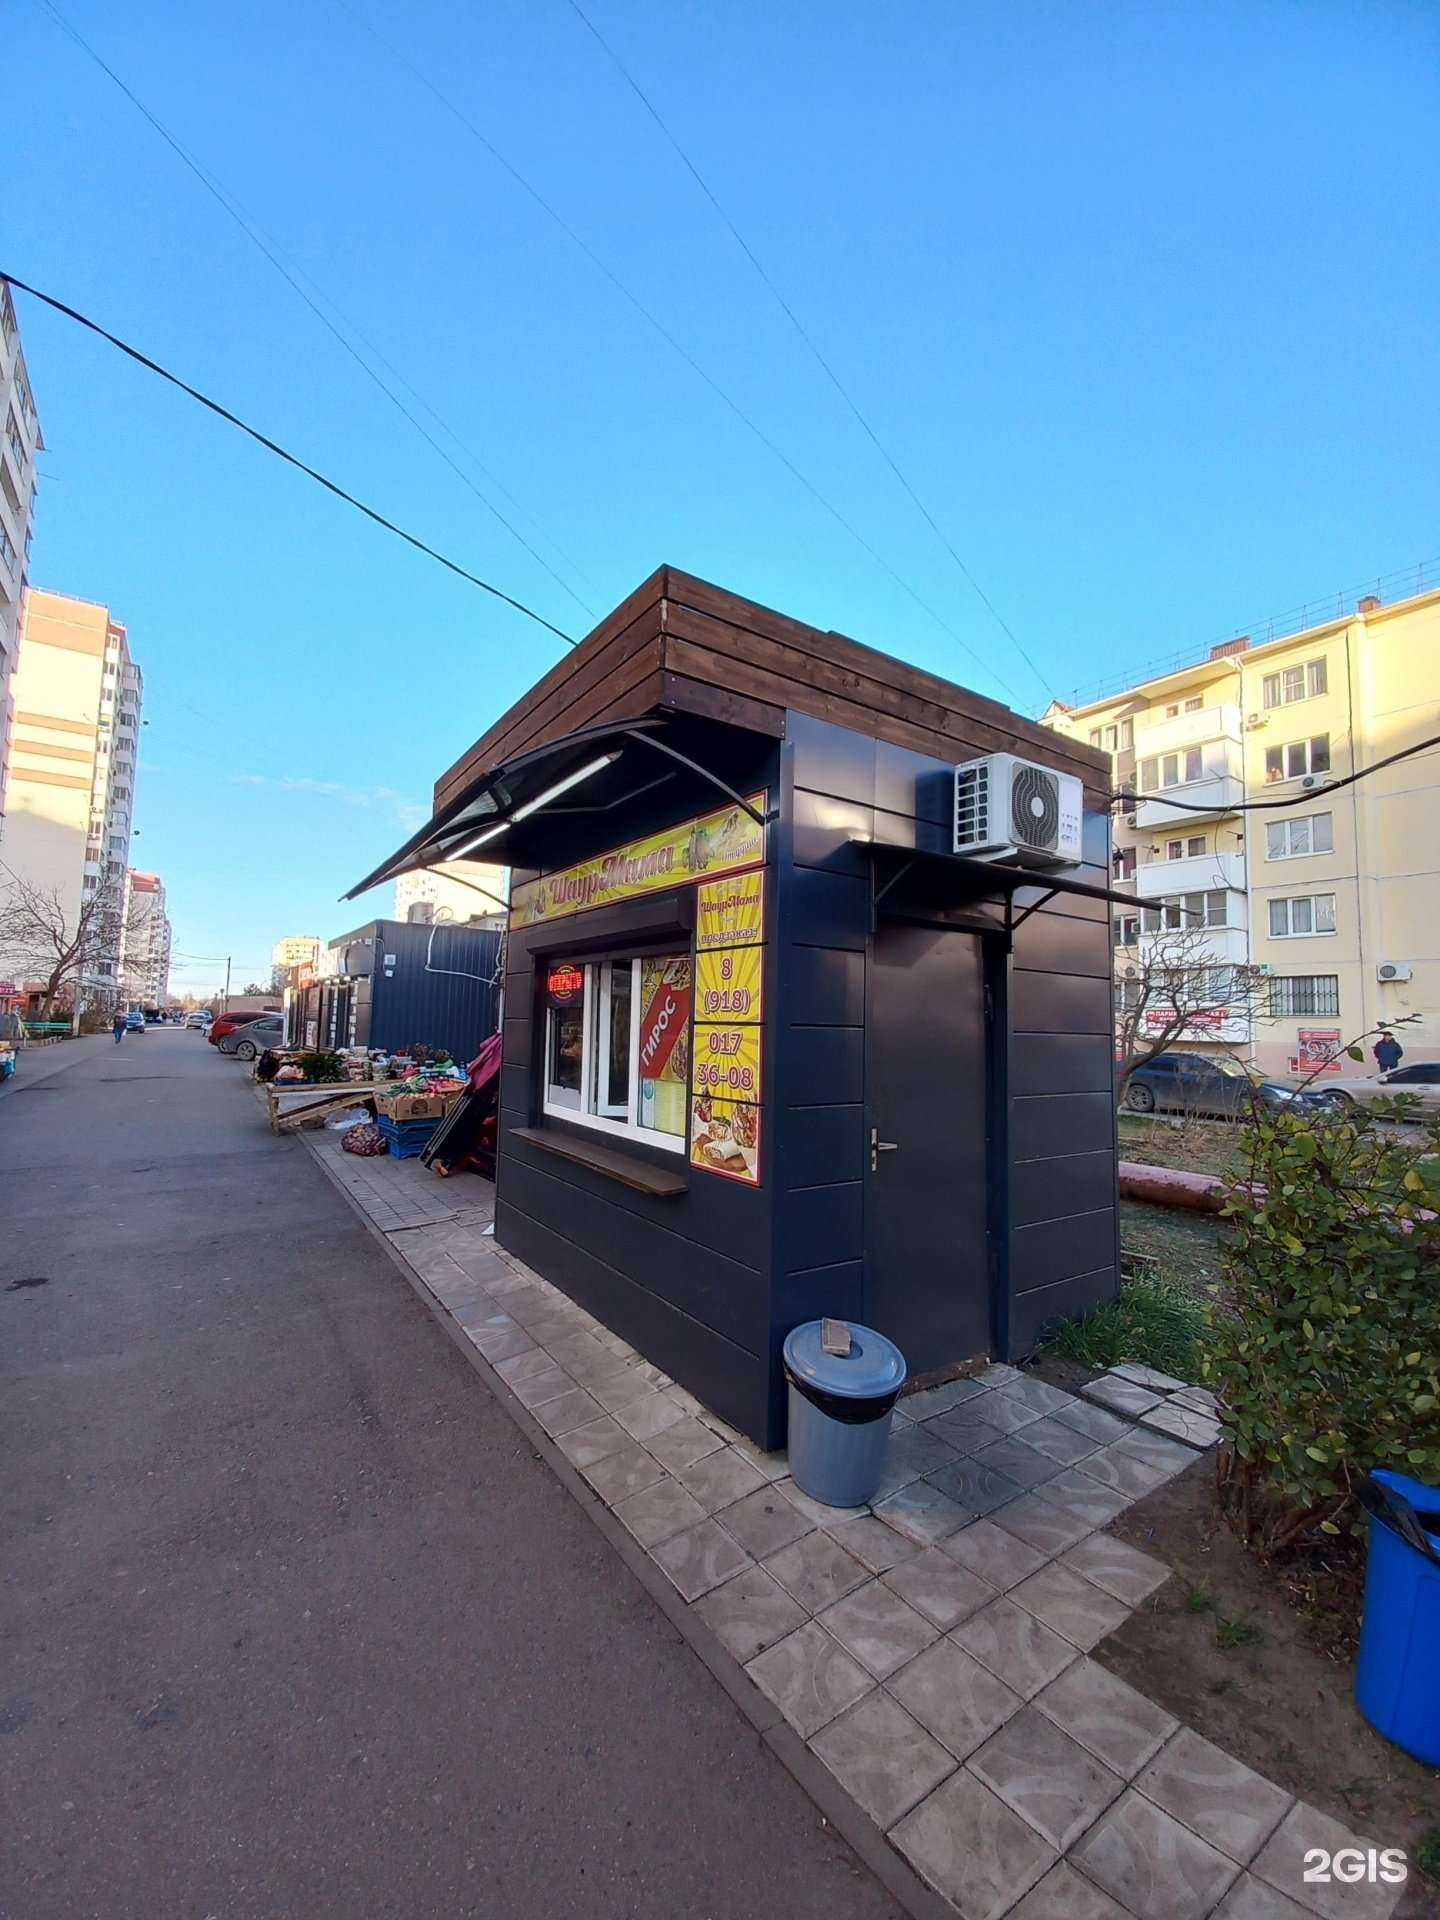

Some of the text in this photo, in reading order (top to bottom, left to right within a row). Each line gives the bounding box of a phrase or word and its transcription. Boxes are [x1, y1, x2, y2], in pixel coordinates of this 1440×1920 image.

[720, 956, 733, 980] 8
[704, 988, 751, 1015] (918)
[641, 995, 677, 1067] ГИРОС
[708, 1032, 743, 1055] 017
[697, 1063, 753, 1090] 36-08
